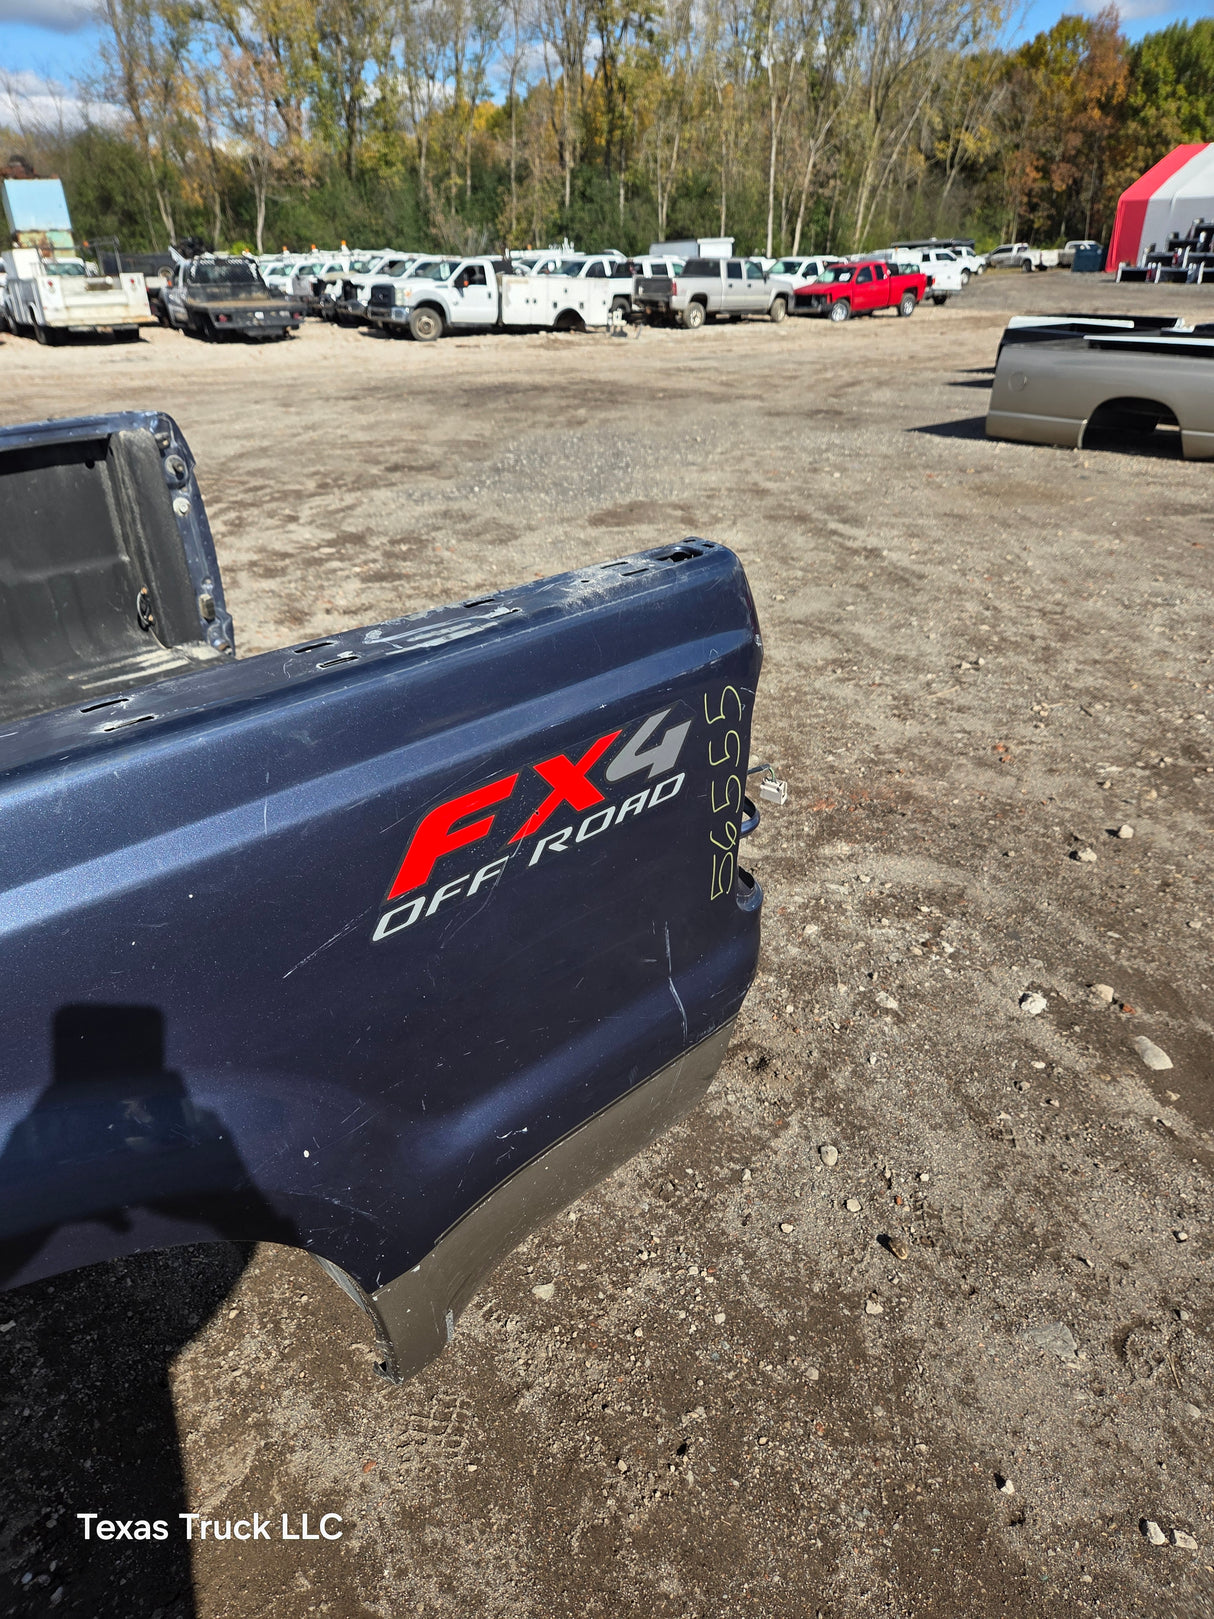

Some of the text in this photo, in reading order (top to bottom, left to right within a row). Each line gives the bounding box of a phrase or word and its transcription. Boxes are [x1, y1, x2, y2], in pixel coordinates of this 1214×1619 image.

[372, 772, 686, 942] OFF ROAD
[386, 708, 692, 901] FX4
[704, 685, 742, 901] 56555
